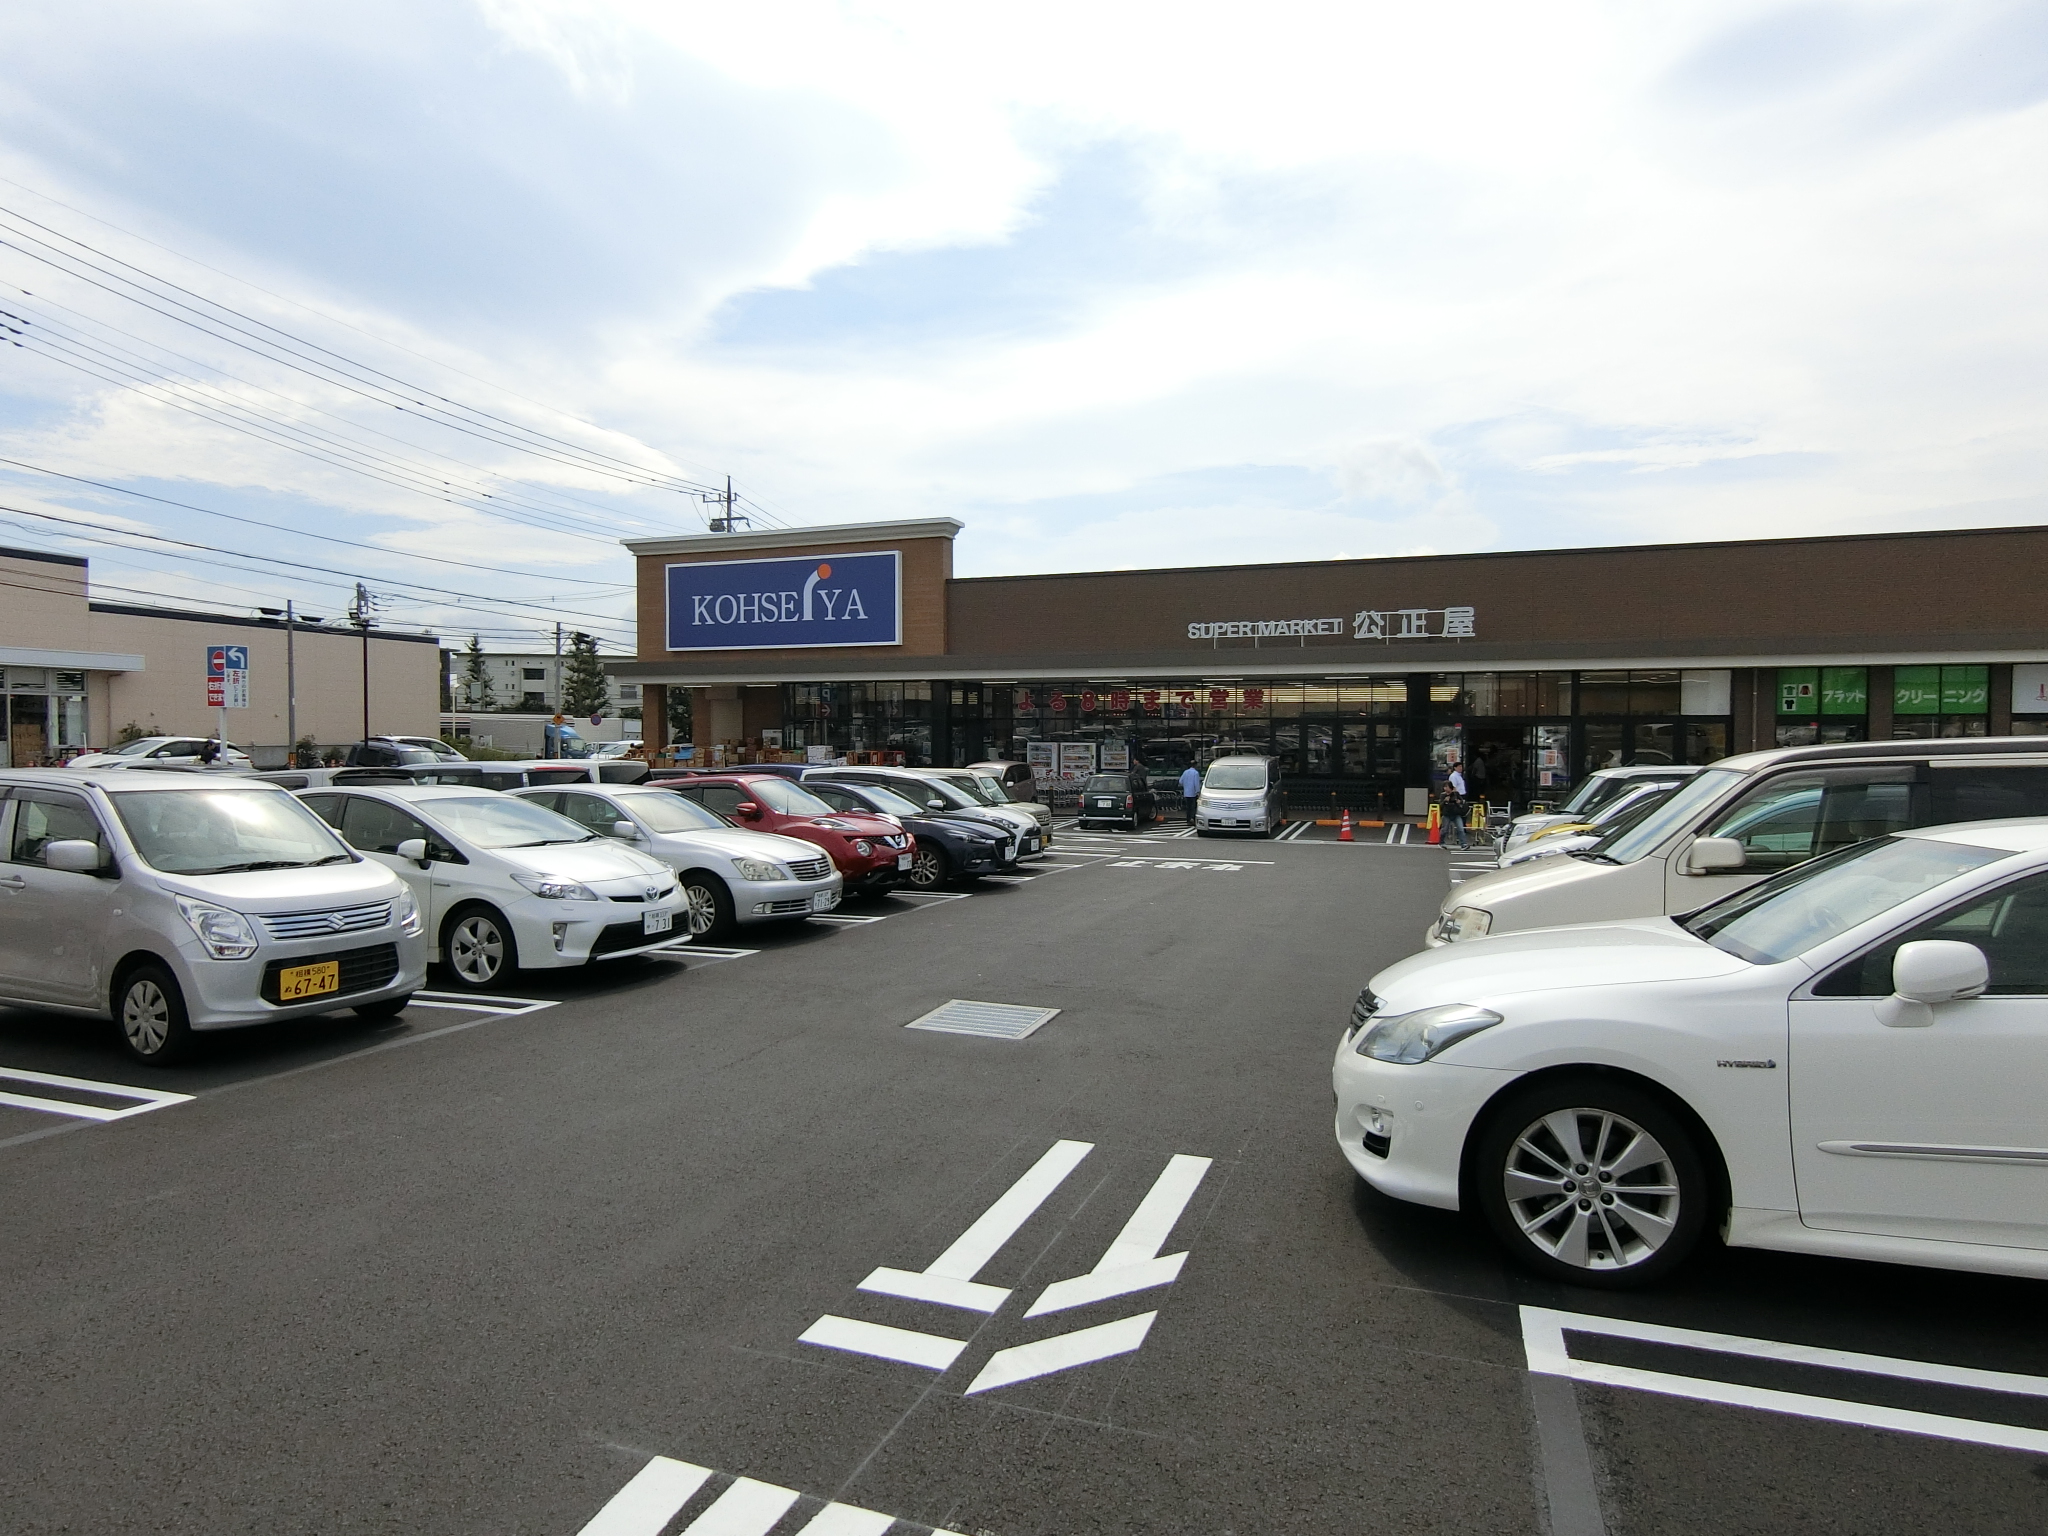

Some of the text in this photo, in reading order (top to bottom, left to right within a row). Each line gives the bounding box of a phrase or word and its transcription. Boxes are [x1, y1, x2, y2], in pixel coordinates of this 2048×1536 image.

[692, 563, 868, 625] KOHSEIYA
[1188, 618, 1343, 639] SUPER MARKET
[1353, 606, 1476, 639] 公正屋
[1018, 688, 1264, 711] よる8時まで営業
[1822, 690, 1866, 703] フラット
[1896, 688, 1986, 704] クリーニング
[295, 974, 335, 994] 67-47
